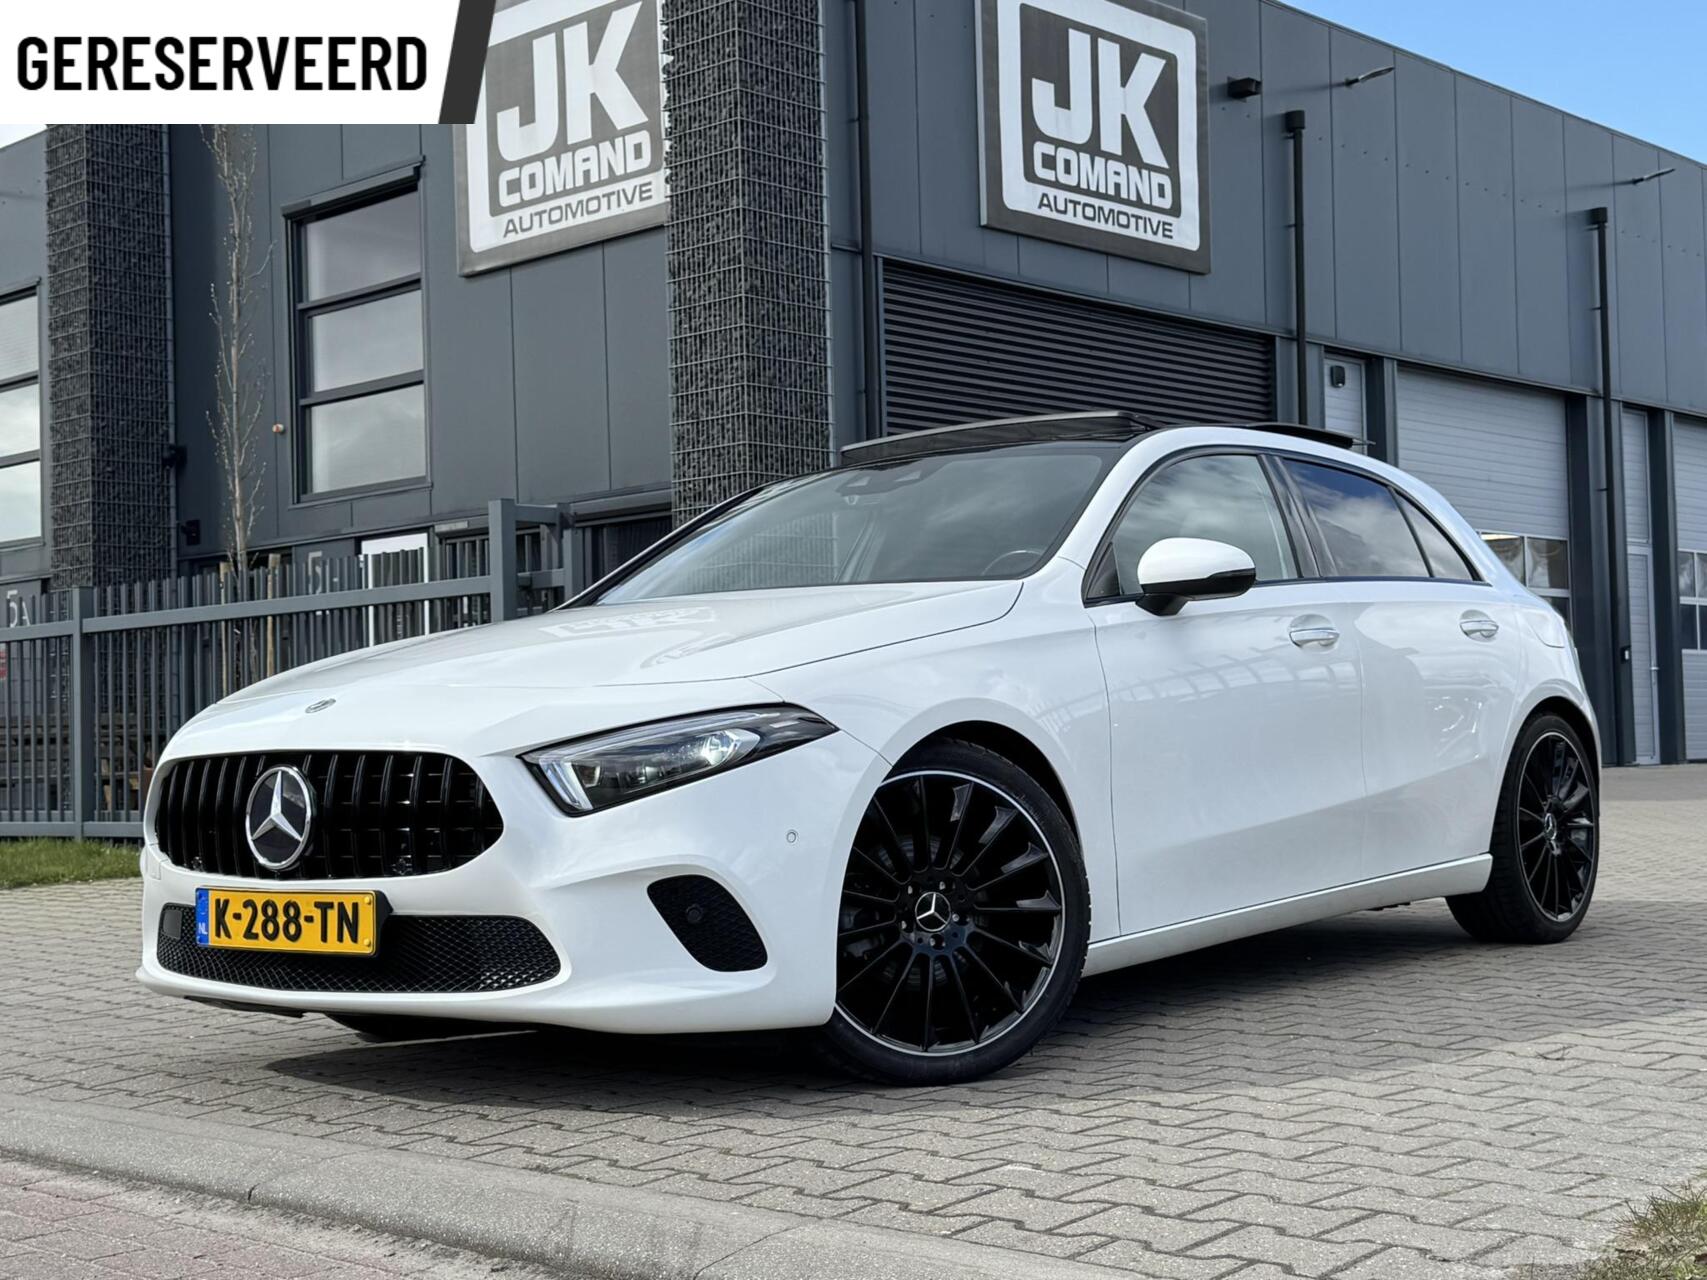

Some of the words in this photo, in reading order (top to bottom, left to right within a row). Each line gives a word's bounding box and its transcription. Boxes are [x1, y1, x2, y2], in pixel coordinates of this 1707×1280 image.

[496, 1, 649, 162] JK
[1032, 28, 1170, 169] JK
[498, 129, 651, 207] COMAND
[1033, 141, 1173, 210] COMAND
[503, 181, 653, 238] AUTOMOTIVE
[1037, 193, 1174, 239] AUTOMOTIVE
[214, 897, 359, 944] K-288-TN
